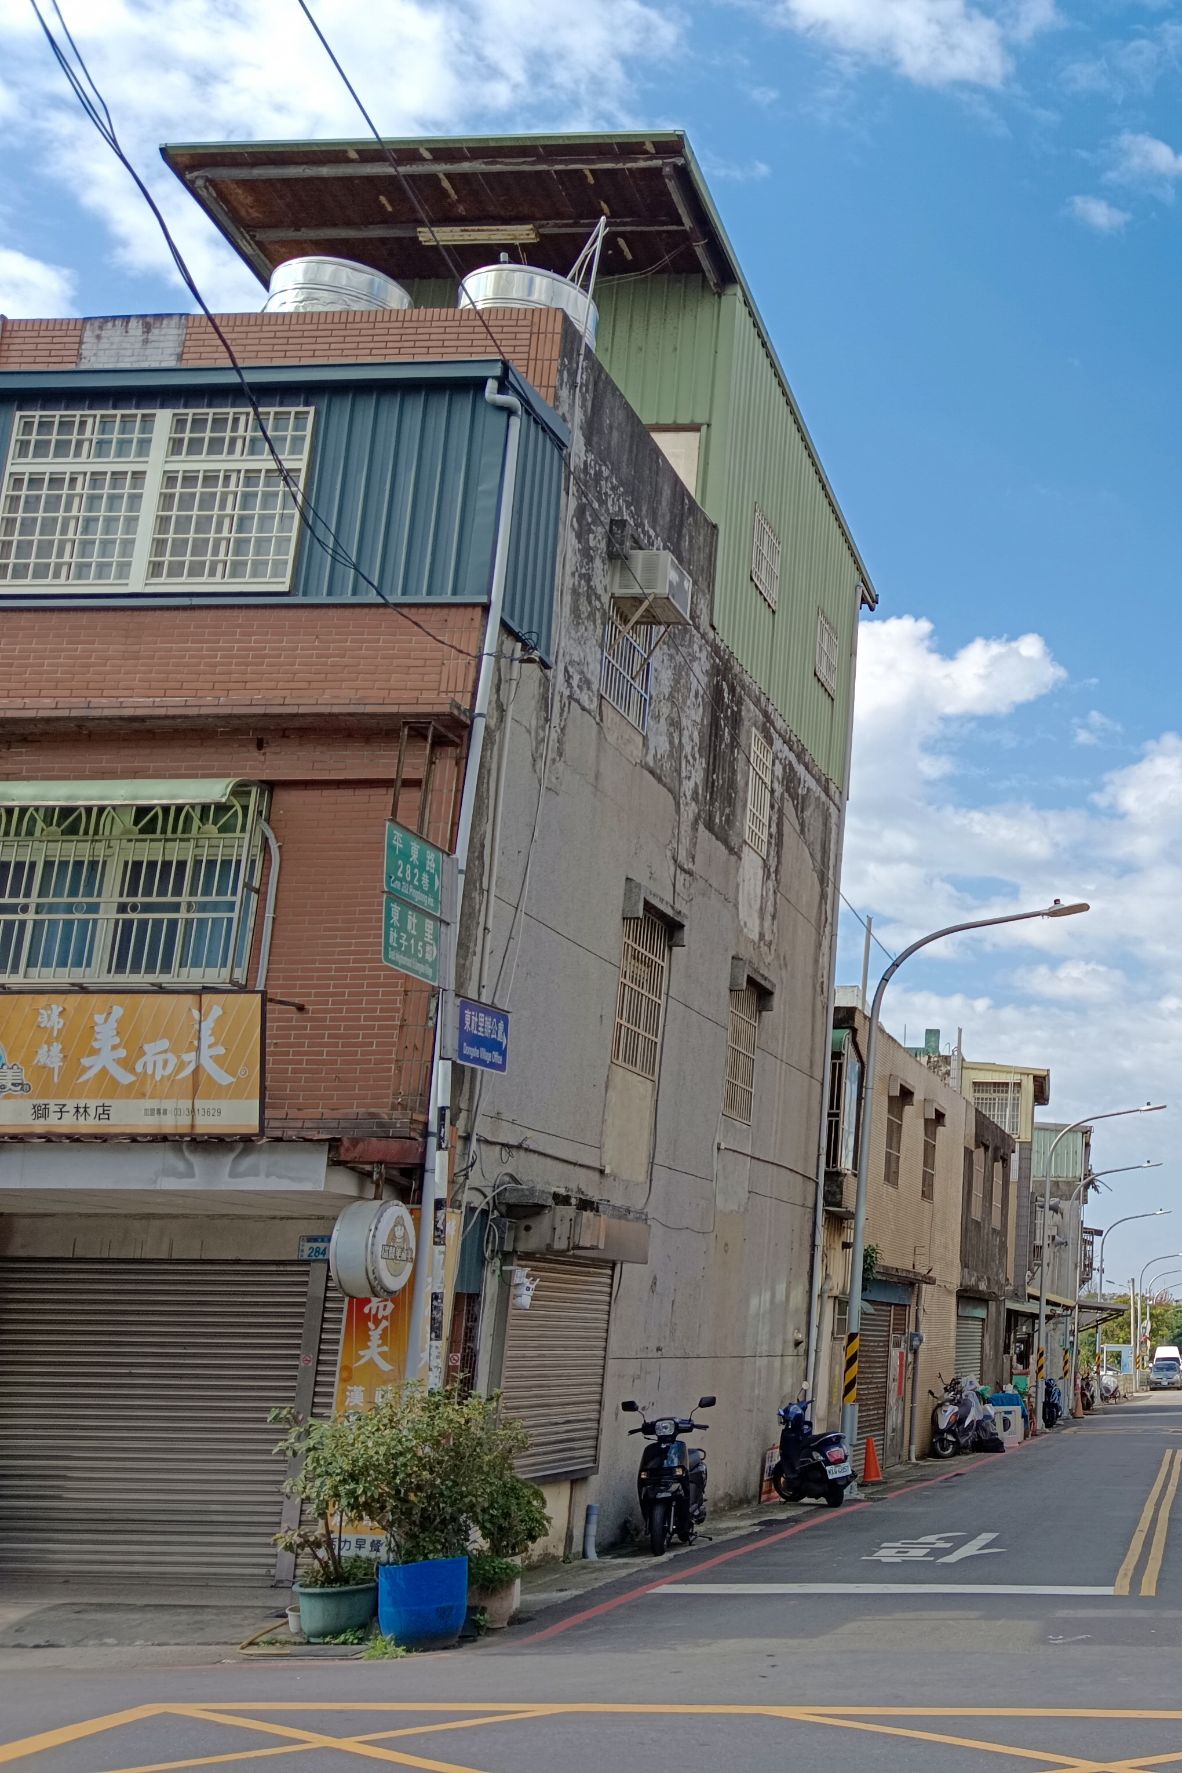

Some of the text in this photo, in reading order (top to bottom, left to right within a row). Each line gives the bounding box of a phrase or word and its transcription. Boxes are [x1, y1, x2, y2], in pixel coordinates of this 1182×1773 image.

[392, 830, 436, 874] 平東路
[397, 860, 430, 891] 282巷
[390, 902, 434, 945] 東社里
[76, 1004, 236, 1086] 美而美
[31, 1103, 112, 1121] 獅子林店
[307, 1246, 327, 1258] 284
